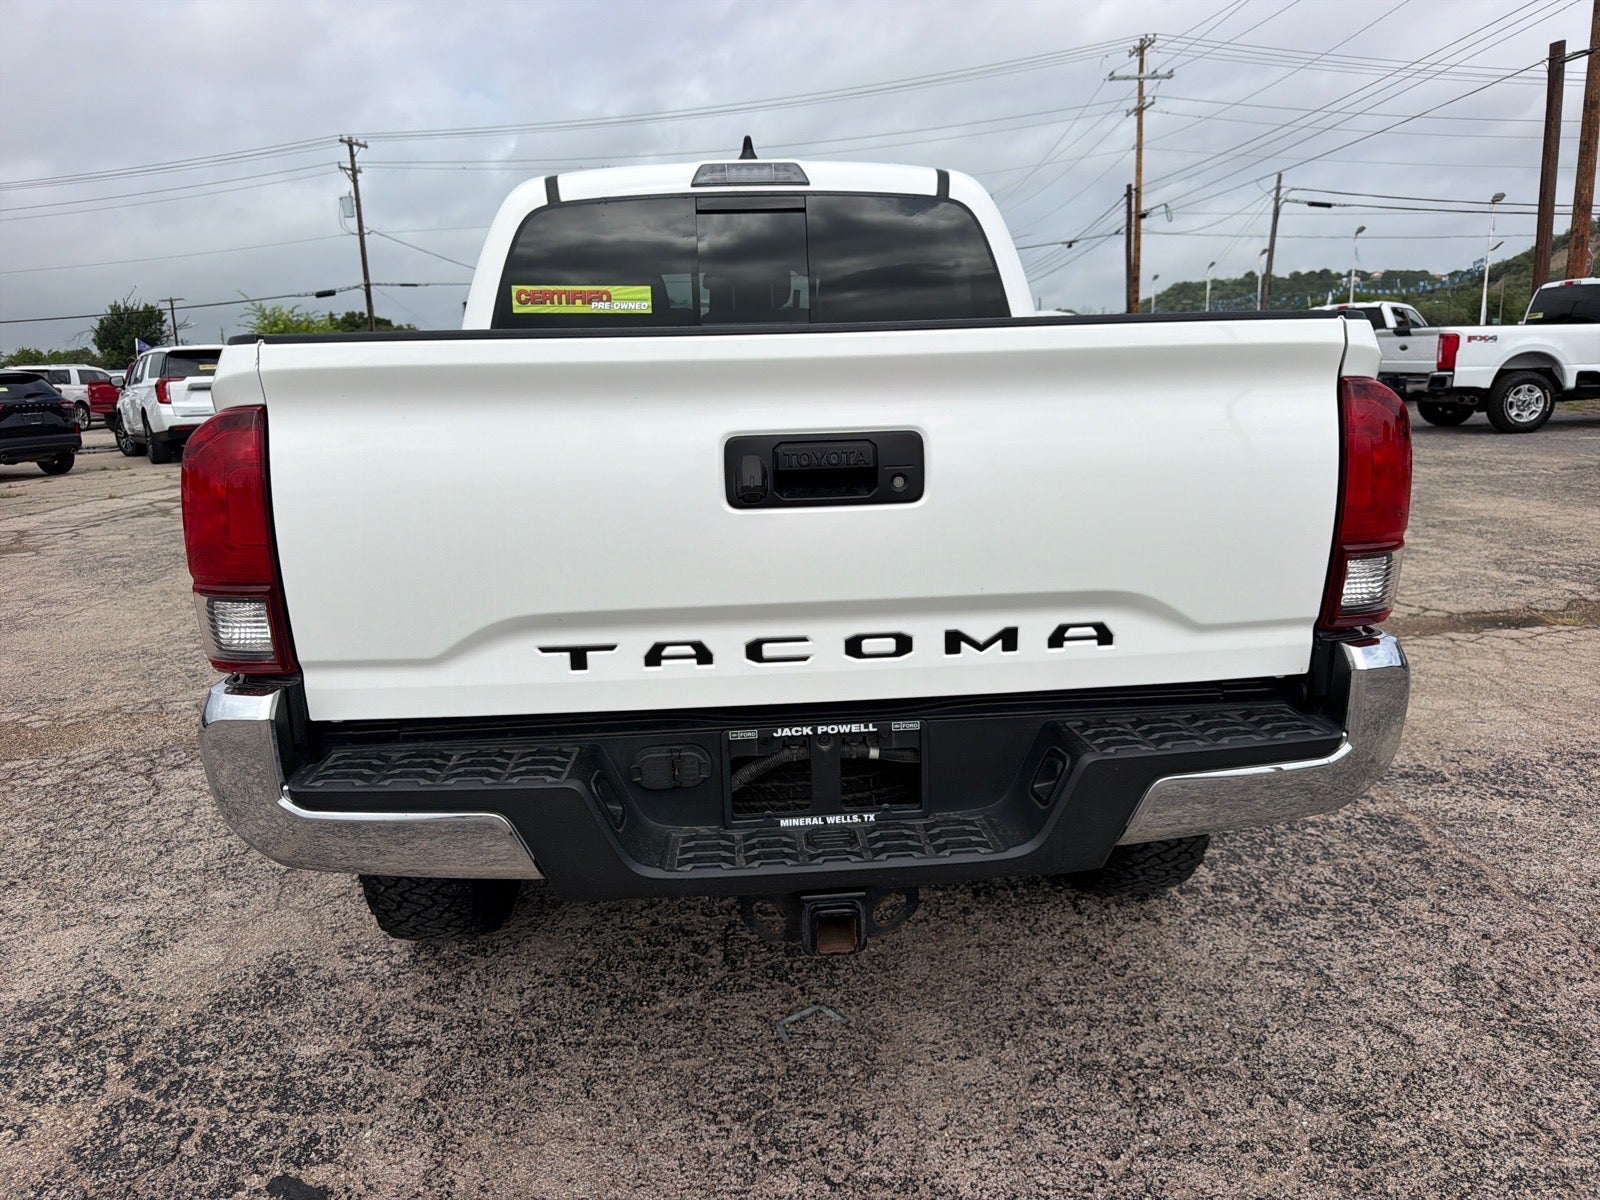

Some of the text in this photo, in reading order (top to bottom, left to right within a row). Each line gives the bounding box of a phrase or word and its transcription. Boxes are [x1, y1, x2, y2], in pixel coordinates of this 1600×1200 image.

[515, 288, 612, 305] CERTIFIED
[591, 301, 649, 310] PRE-OWNED
[1467, 335, 1497, 343] FX4
[783, 451, 869, 467] TOYOTA
[537, 621, 1114, 671] TACOMA
[772, 723, 878, 737] JACK POWELL
[780, 814, 875, 827] MINERAL WELLS, TX
